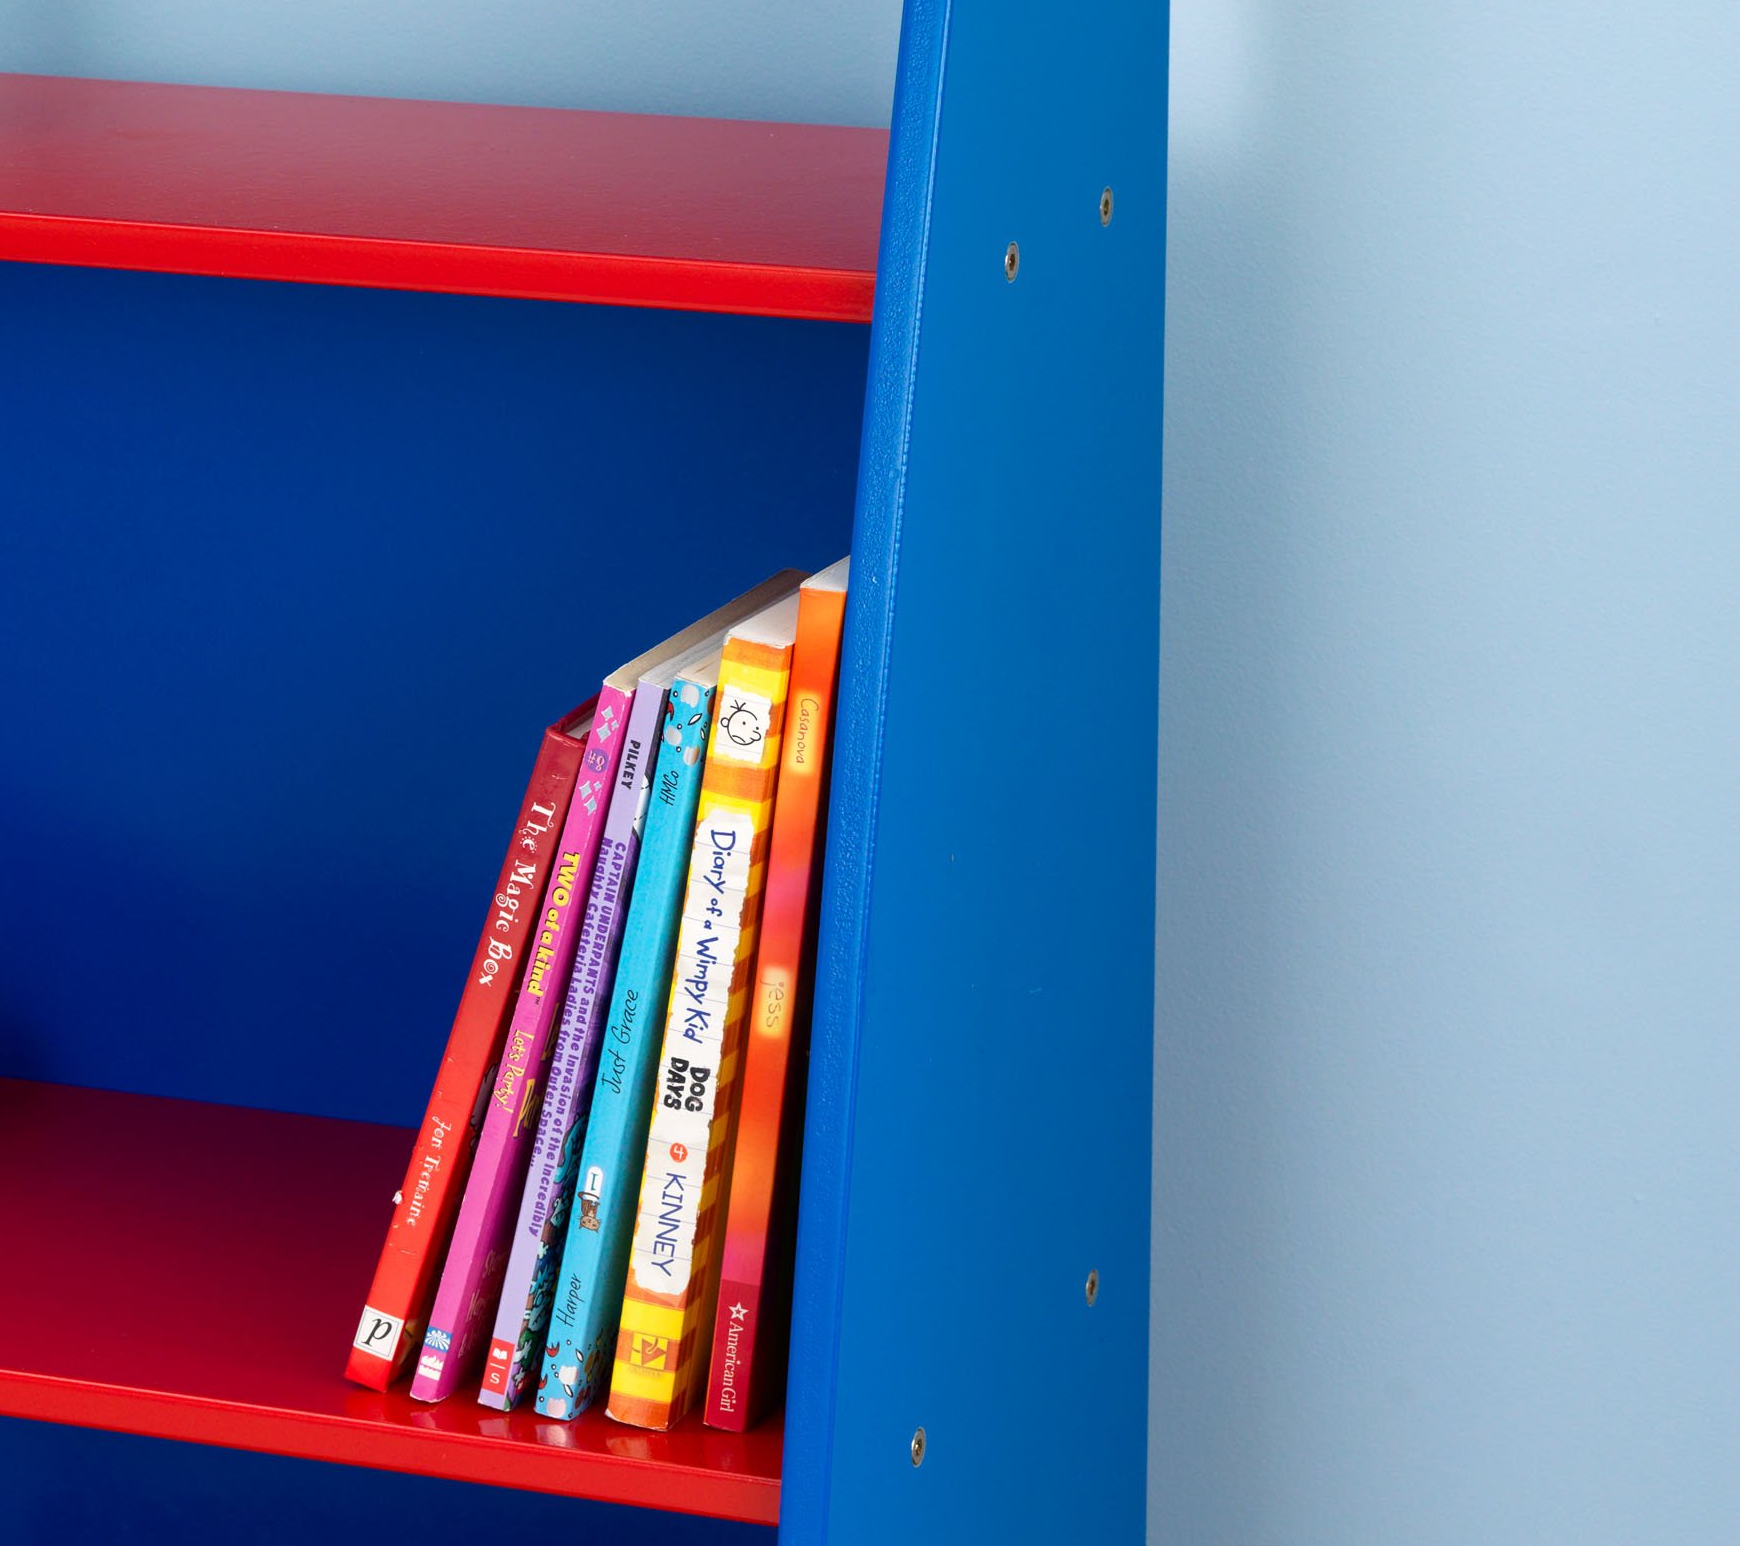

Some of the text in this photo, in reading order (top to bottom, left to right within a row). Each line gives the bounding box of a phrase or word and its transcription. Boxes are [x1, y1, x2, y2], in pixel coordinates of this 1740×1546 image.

[795, 698, 820, 764] Casanova
[621, 739, 641, 790] PILKEY
[659, 770, 679, 806] HMCo
[479, 802, 557, 987] The Magic Box
[552, 851, 581, 908] TWO
[591, 837, 614, 900] Naughty
[539, 930, 553, 945] a
[544, 907, 560, 931] of
[573, 903, 599, 974] Cafeteria
[682, 829, 737, 1044] Diary of a Wimpy Kid
[562, 976, 582, 1026] Ladies
[508, 1029, 535, 1062] Let's
[528, 842, 627, 1238] CAPTAIN UNDERPANTS and the Invasion of the Incredibly
[554, 1027, 571, 1063] from
[601, 989, 639, 1094] Just Grace
[493, 1063, 525, 1114] Party!
[544, 1065, 562, 1108] Outer
[663, 1056, 690, 1111] DAYS
[684, 1066, 711, 1112] DOG
[407, 1155, 441, 1226] Tremaine
[651, 1173, 687, 1276] KINNEY
[556, 1273, 584, 1327] Harper
